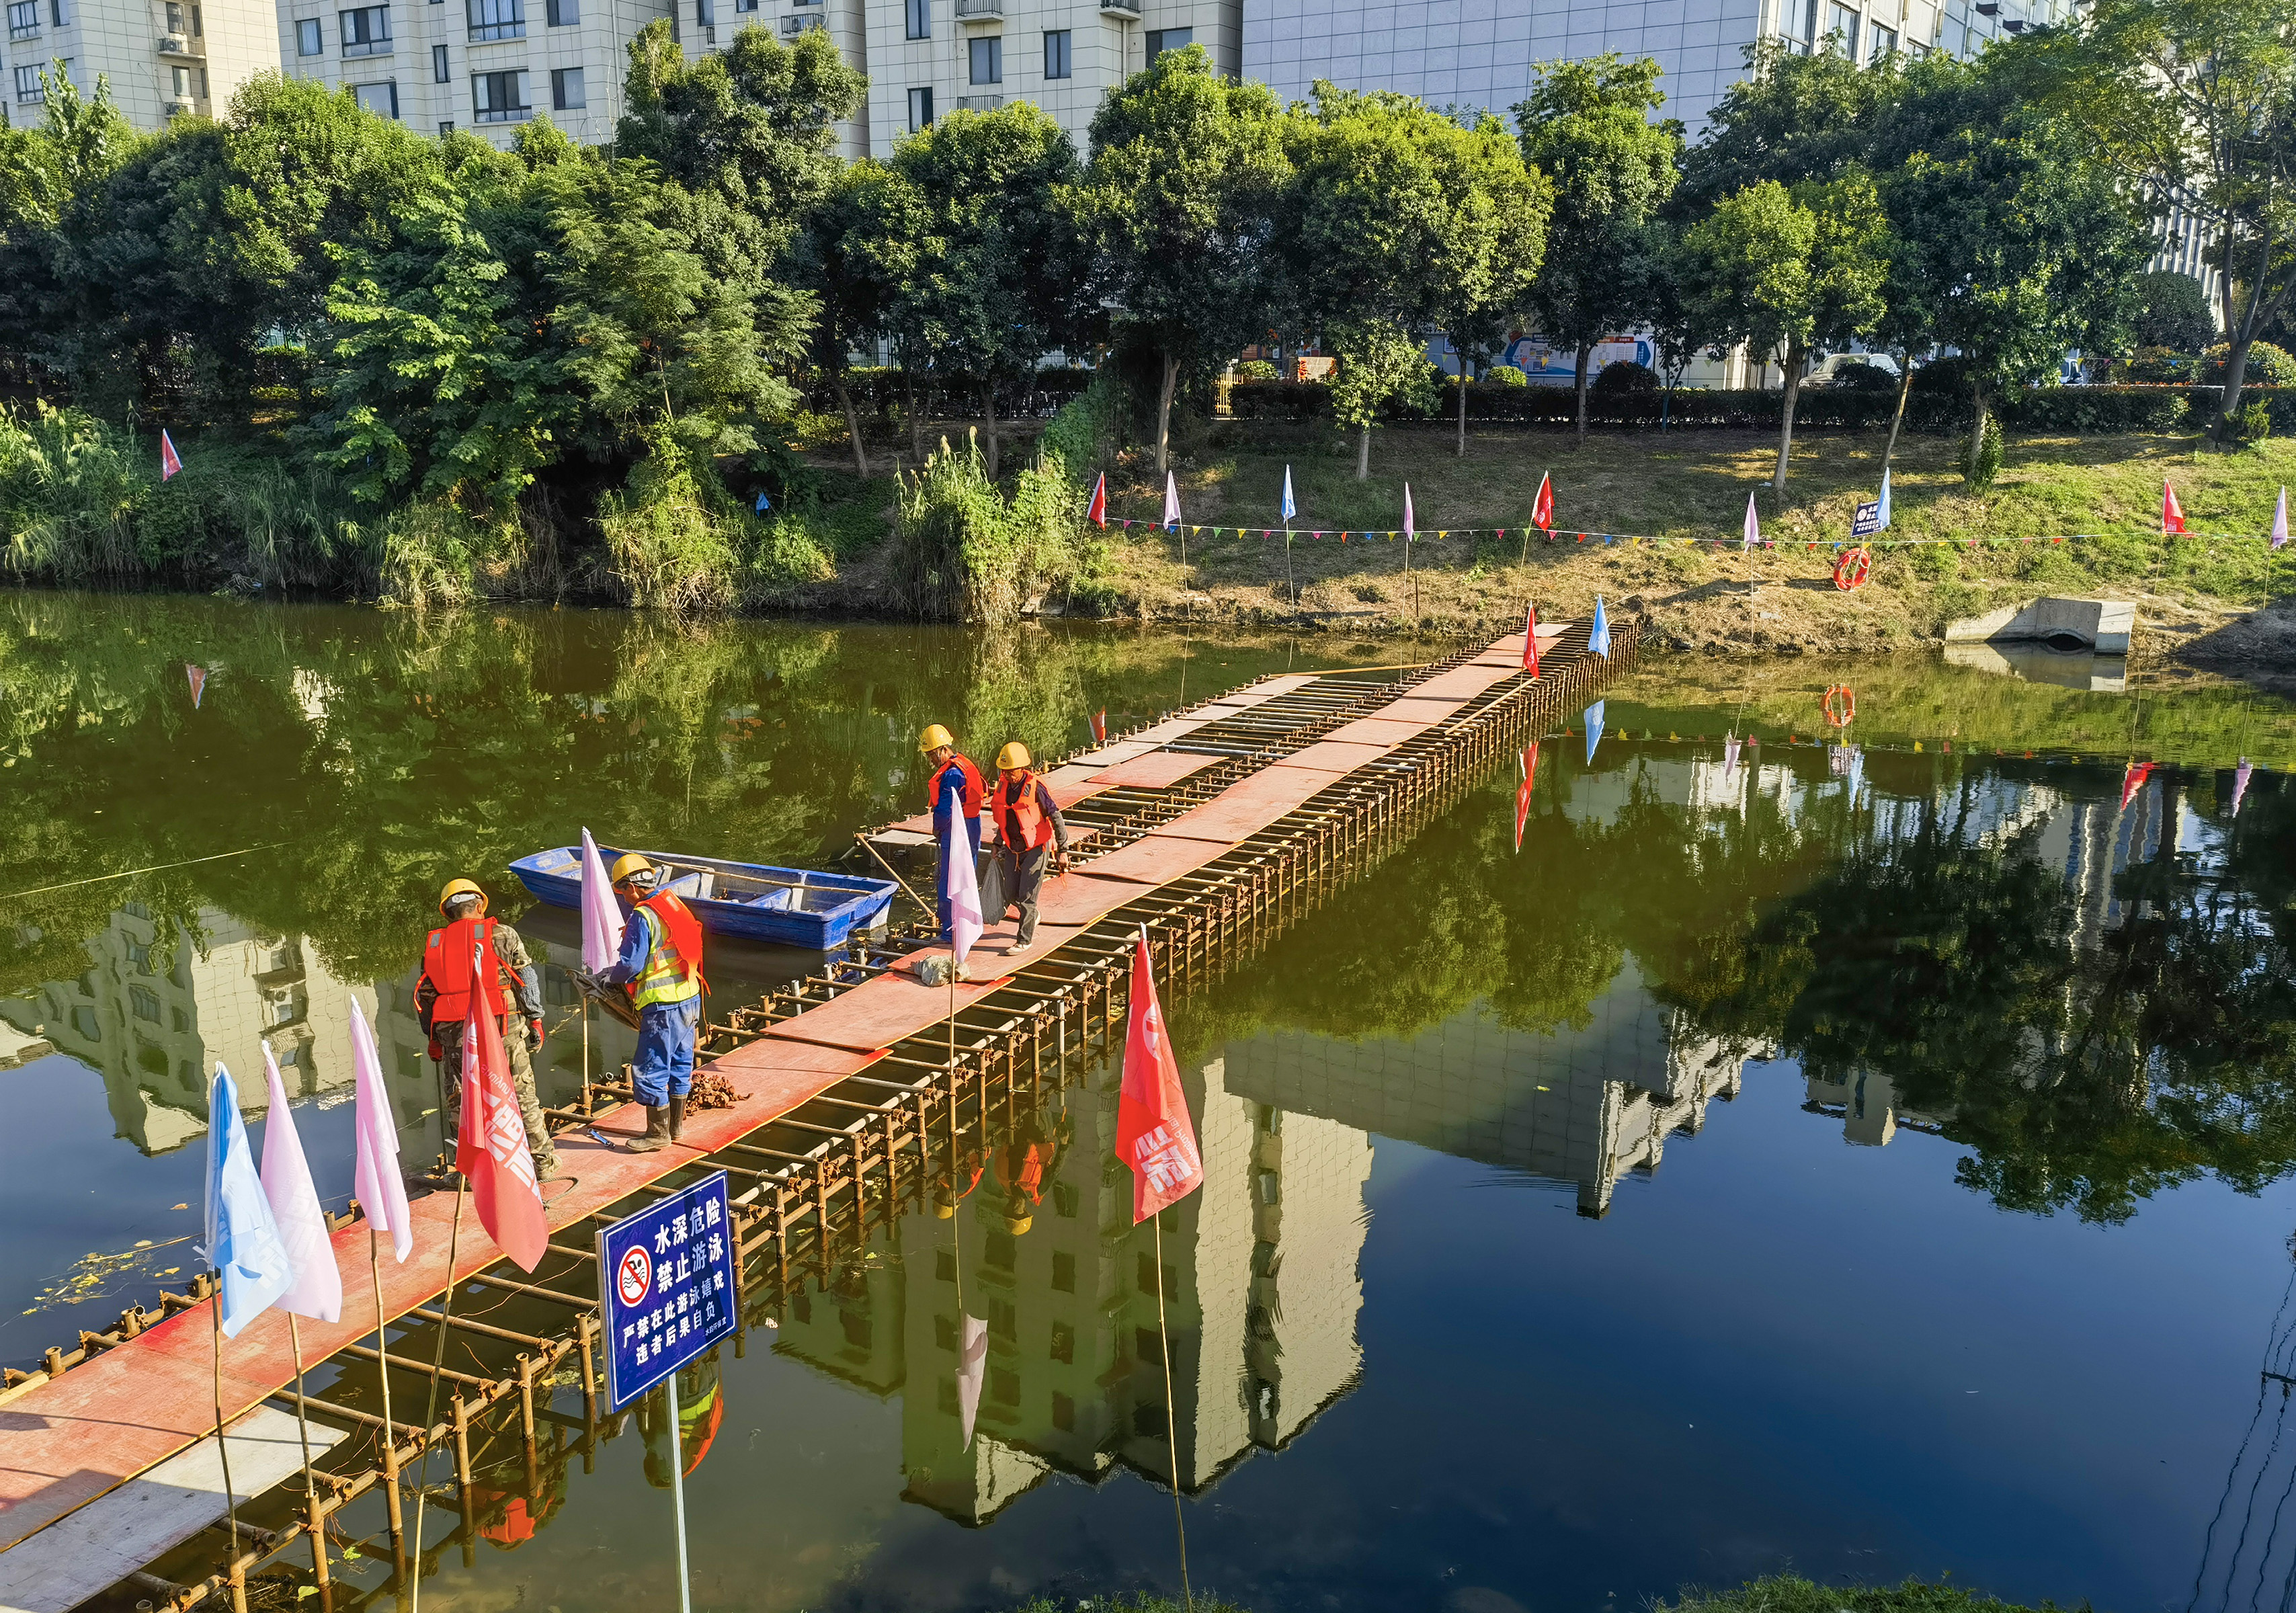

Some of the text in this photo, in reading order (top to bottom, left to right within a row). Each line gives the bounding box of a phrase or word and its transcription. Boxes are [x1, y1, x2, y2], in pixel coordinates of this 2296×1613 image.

[654, 1196, 722, 1255] 水深危险
[657, 1233, 724, 1294] 禁止游泳
[623, 1272, 725, 1348] 严禁在此游泳嬉戏
[636, 1300, 716, 1366] 违者后果自负
